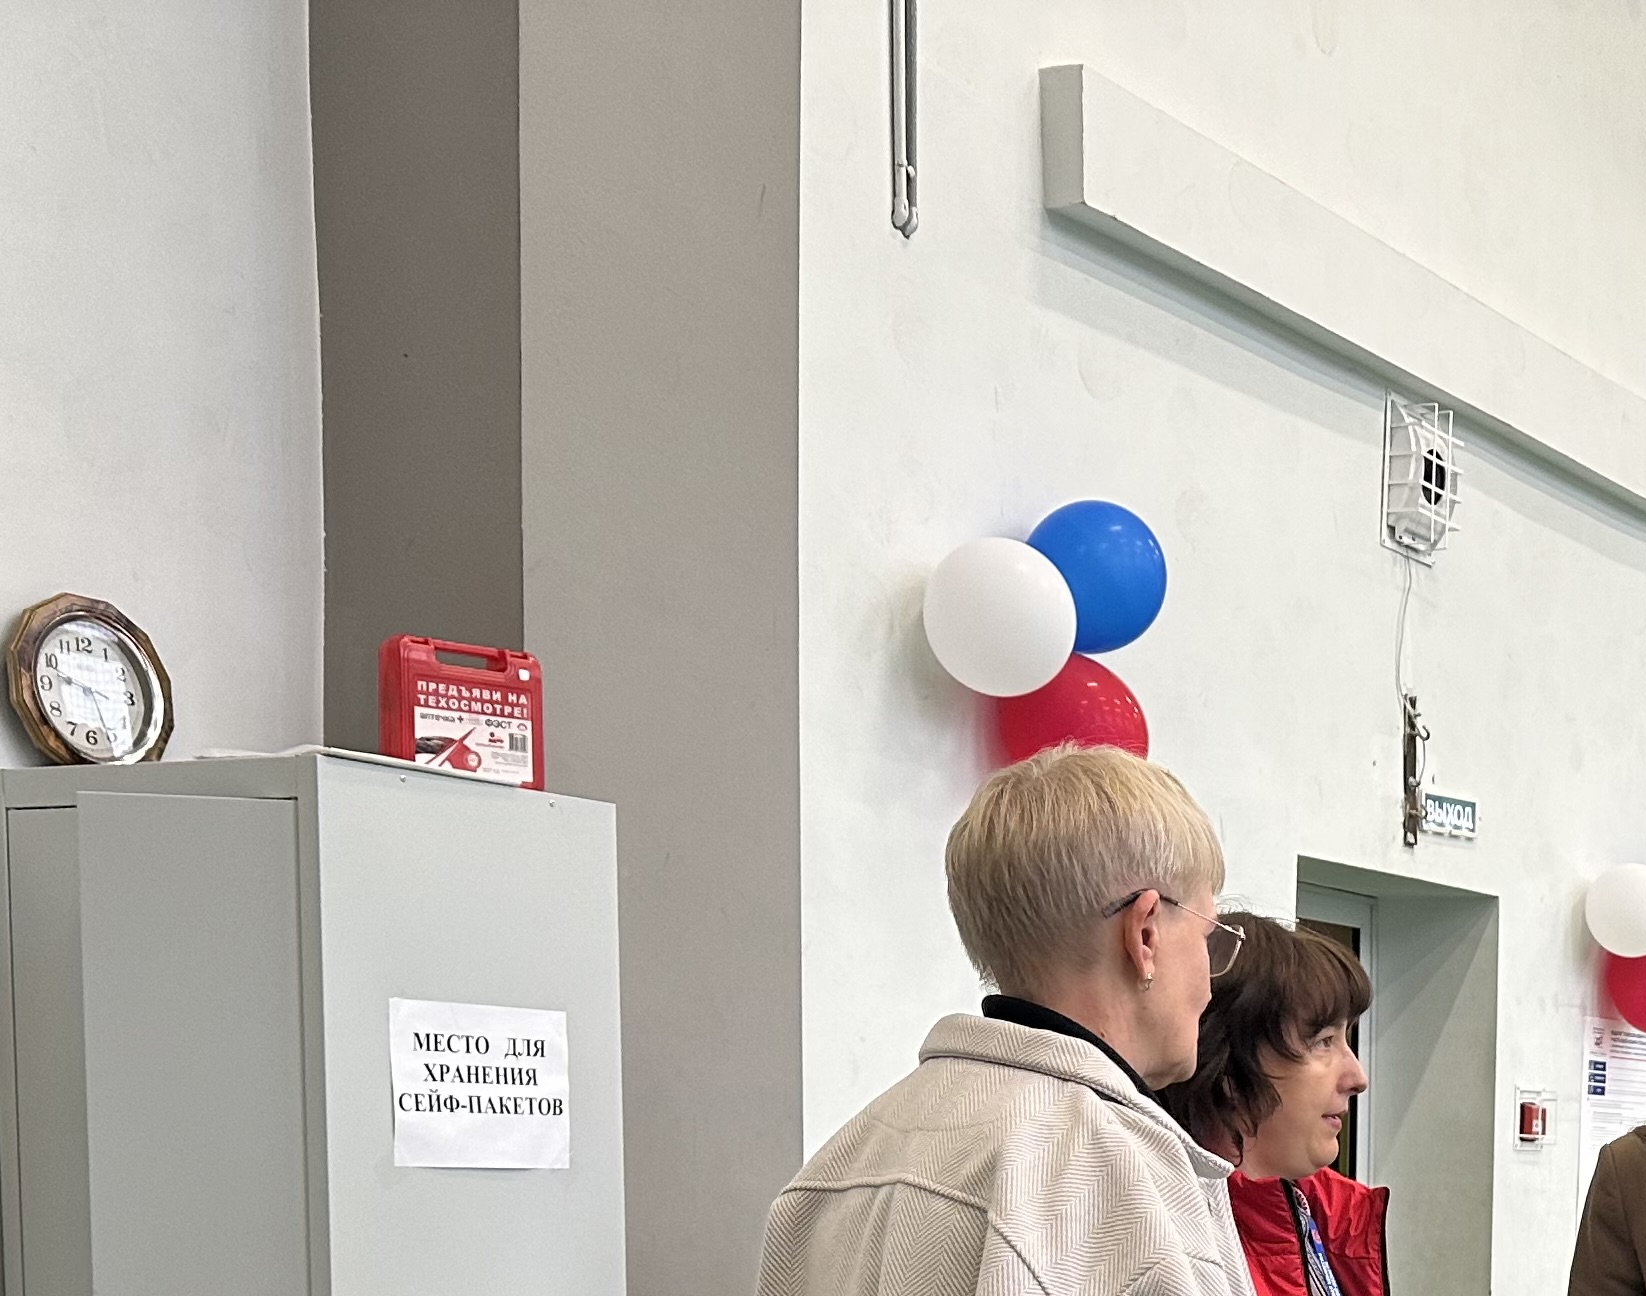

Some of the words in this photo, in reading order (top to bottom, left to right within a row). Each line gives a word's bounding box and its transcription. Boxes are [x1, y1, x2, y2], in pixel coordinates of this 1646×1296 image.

[59, 638, 71, 655] 11
[75, 637, 93, 653] 12
[44, 652, 58, 670] 10
[102, 648, 108, 662] 1
[39, 674, 53, 691] 9
[115, 667, 126, 682] 2
[124, 690, 135, 706] 3
[417, 680, 502, 701] ПРЕДЪЯВИ
[508, 692, 528, 705] НА
[49, 701, 62, 717] 8
[416, 694, 528, 718] ТЕХОСМОТРЕ!
[66, 721, 78, 736] 7
[85, 730, 98, 745] 6
[1426, 799, 1473, 829] ВЫХОД
[413, 1031, 490, 1055] МЕСТО
[504, 1037, 546, 1060] ДЛЯ
[423, 1063, 538, 1086] ХРАНЕНИЯ
[398, 1088, 564, 1116] СЕЙФ-ПАКЕТОВ
